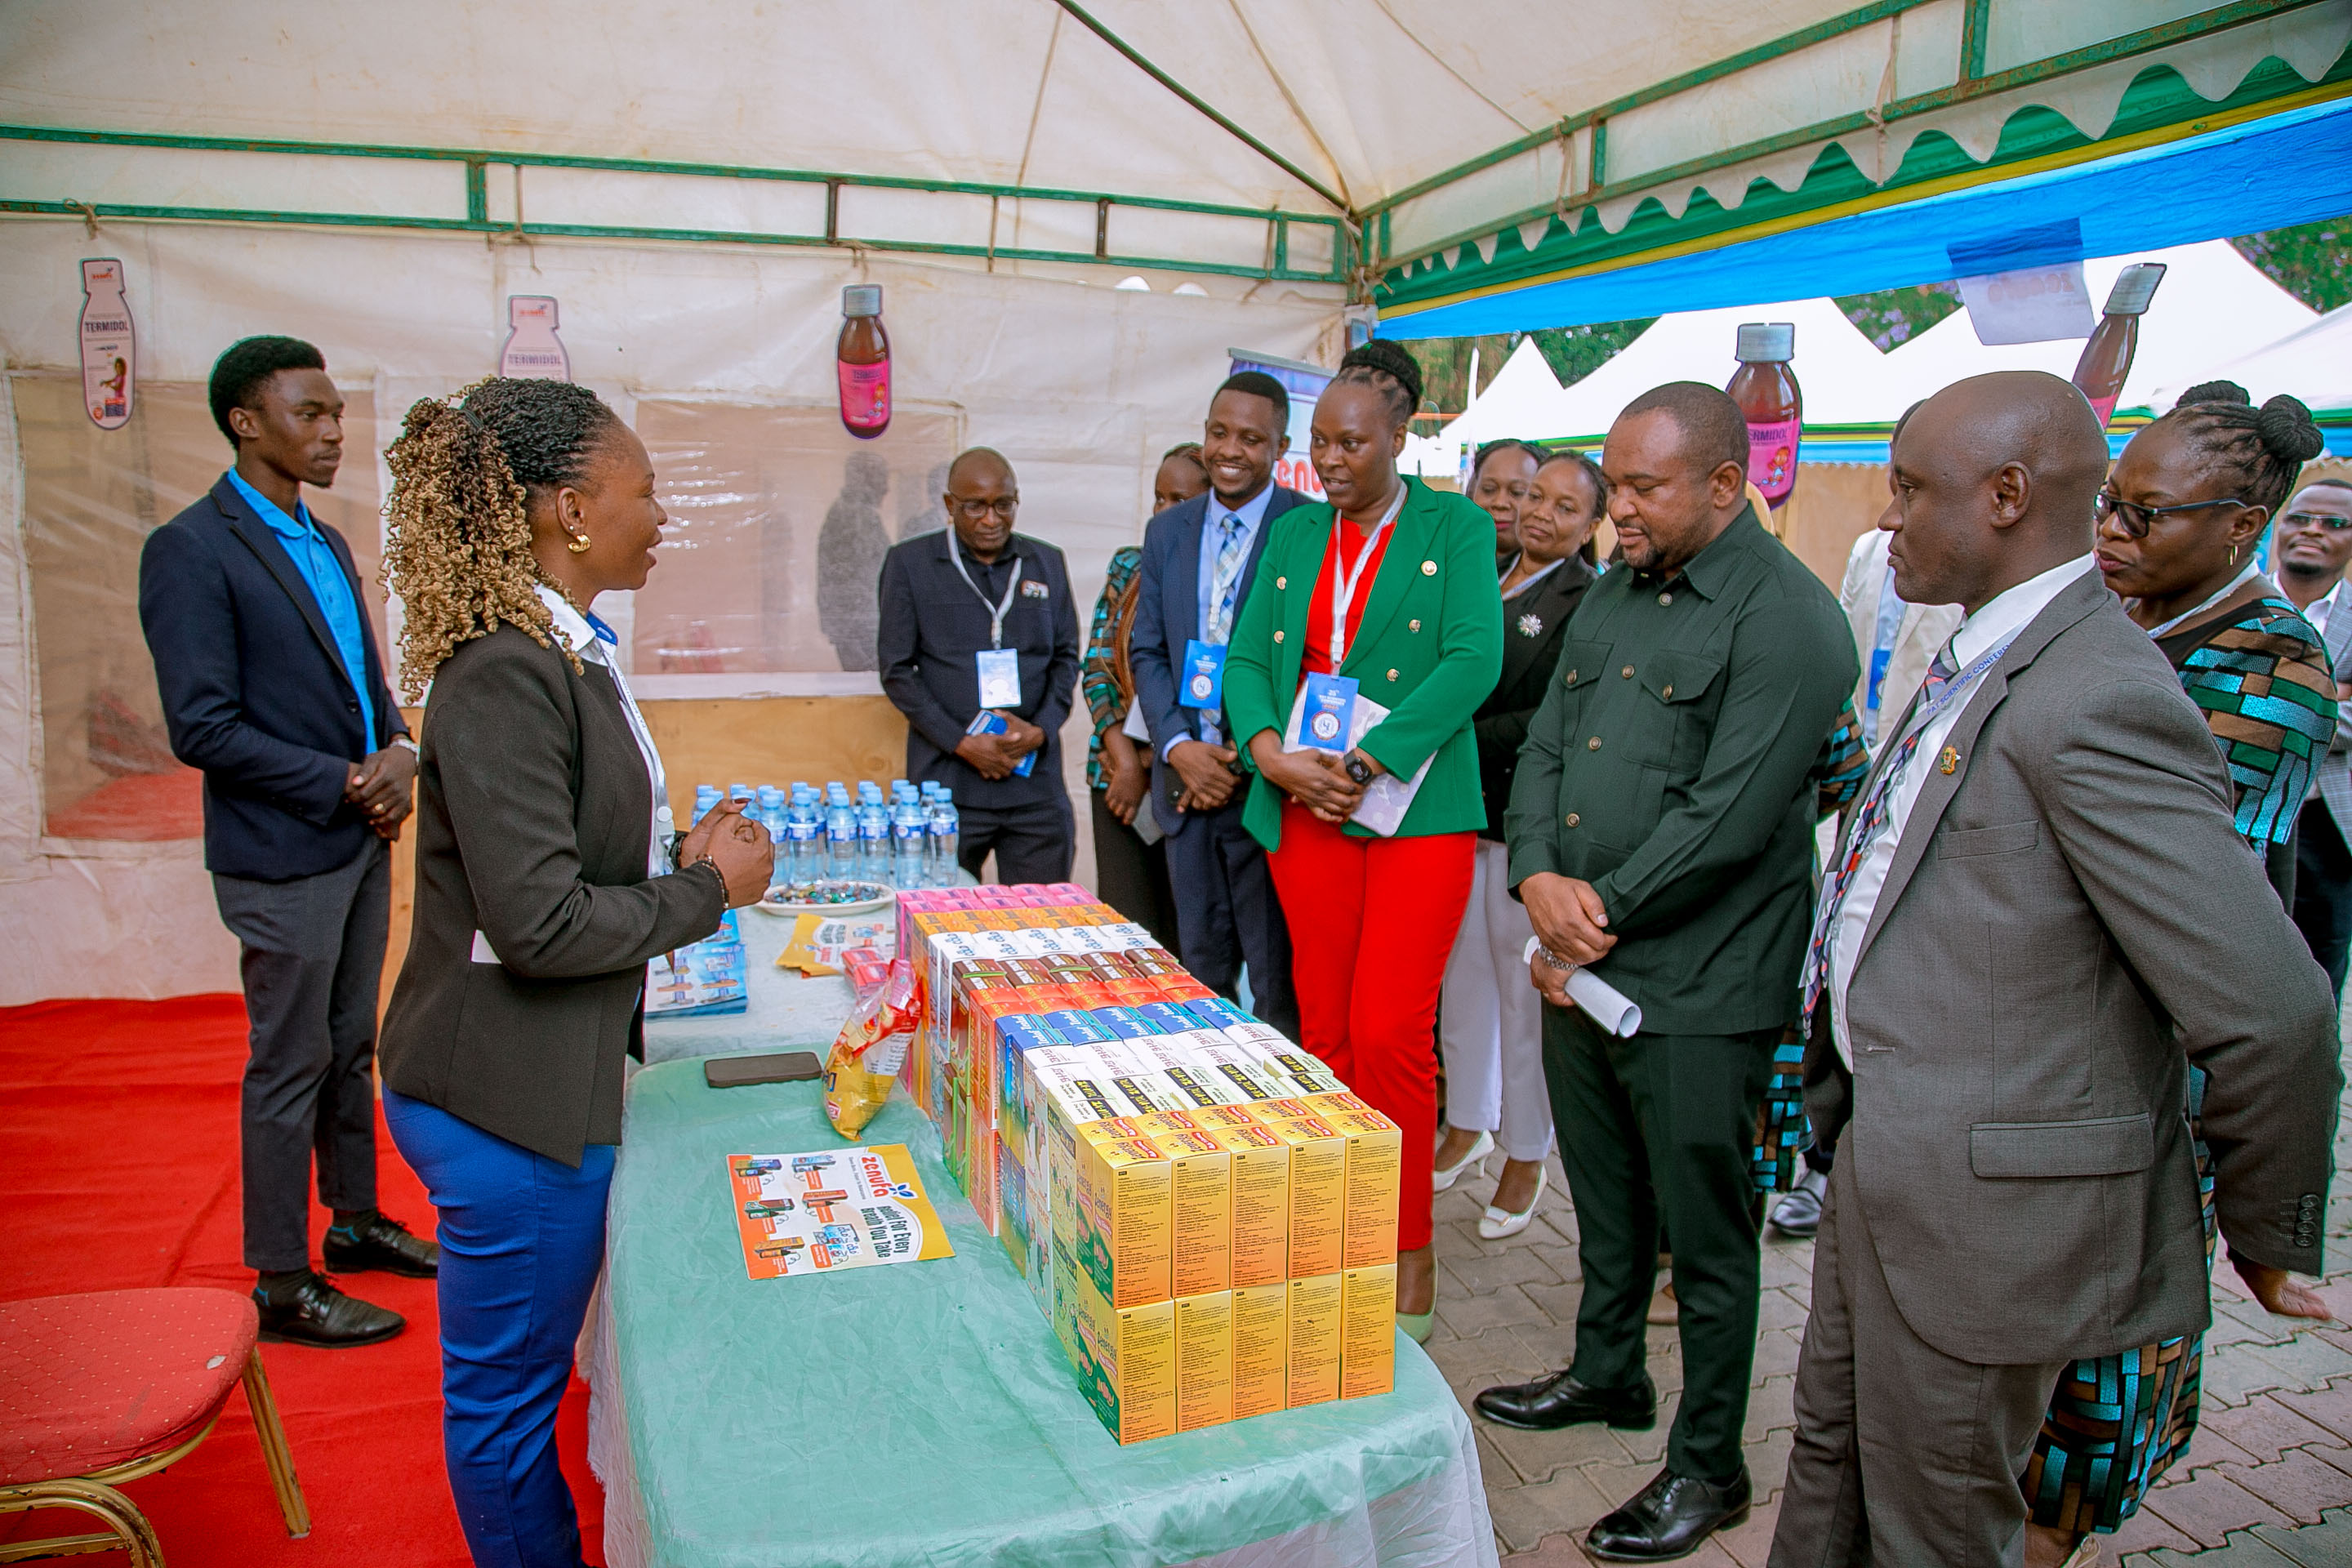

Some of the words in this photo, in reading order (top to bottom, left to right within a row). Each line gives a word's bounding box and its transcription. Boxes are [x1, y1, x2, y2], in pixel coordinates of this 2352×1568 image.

[85, 320, 129, 333] TERMIDOL
[508, 354, 562, 367] TERMIDOL
[1748, 428, 1788, 442] ERMIDOL
[1940, 672, 1973, 705] SCIENTIFIC
[862, 1156, 893, 1198] zenufa
[860, 1207, 884, 1226] Breath
[876, 1205, 905, 1221] Relief
[868, 1225, 888, 1241] You
[889, 1220, 907, 1231] For
[873, 1240, 893, 1258] Take
[893, 1232, 911, 1254] Every
[1097, 1330, 1118, 1361] Zenergy
